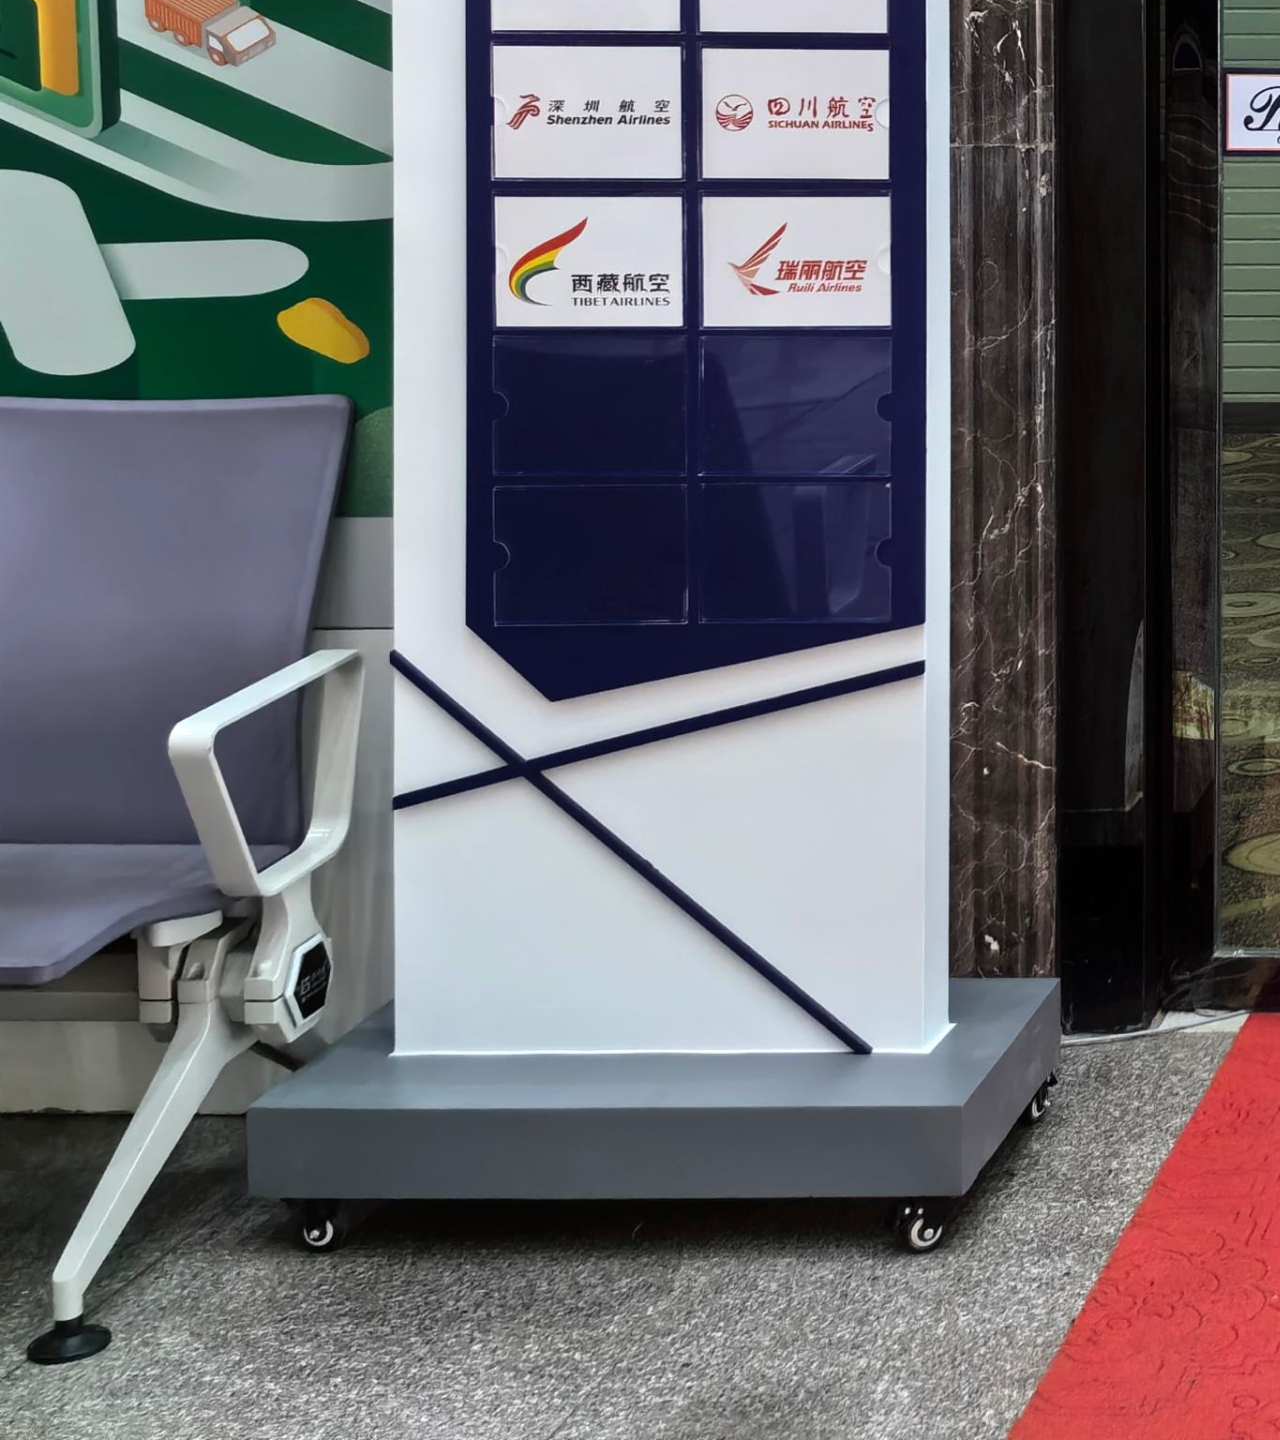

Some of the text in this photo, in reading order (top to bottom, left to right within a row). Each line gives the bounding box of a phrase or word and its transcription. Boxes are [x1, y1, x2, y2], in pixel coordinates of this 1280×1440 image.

[547, 99, 671, 113] 深圳航空
[767, 96, 877, 119] 四川航空
[546, 114, 671, 126] Shenzhen Airlines
[768, 120, 875, 132] SICHUAN AIRLINES
[777, 260, 868, 282] 瑞丽航空
[571, 273, 671, 295] 西藏航空
[787, 282, 863, 293] Ruili Airlines
[572, 296, 671, 307] TIBET AIRLINES
